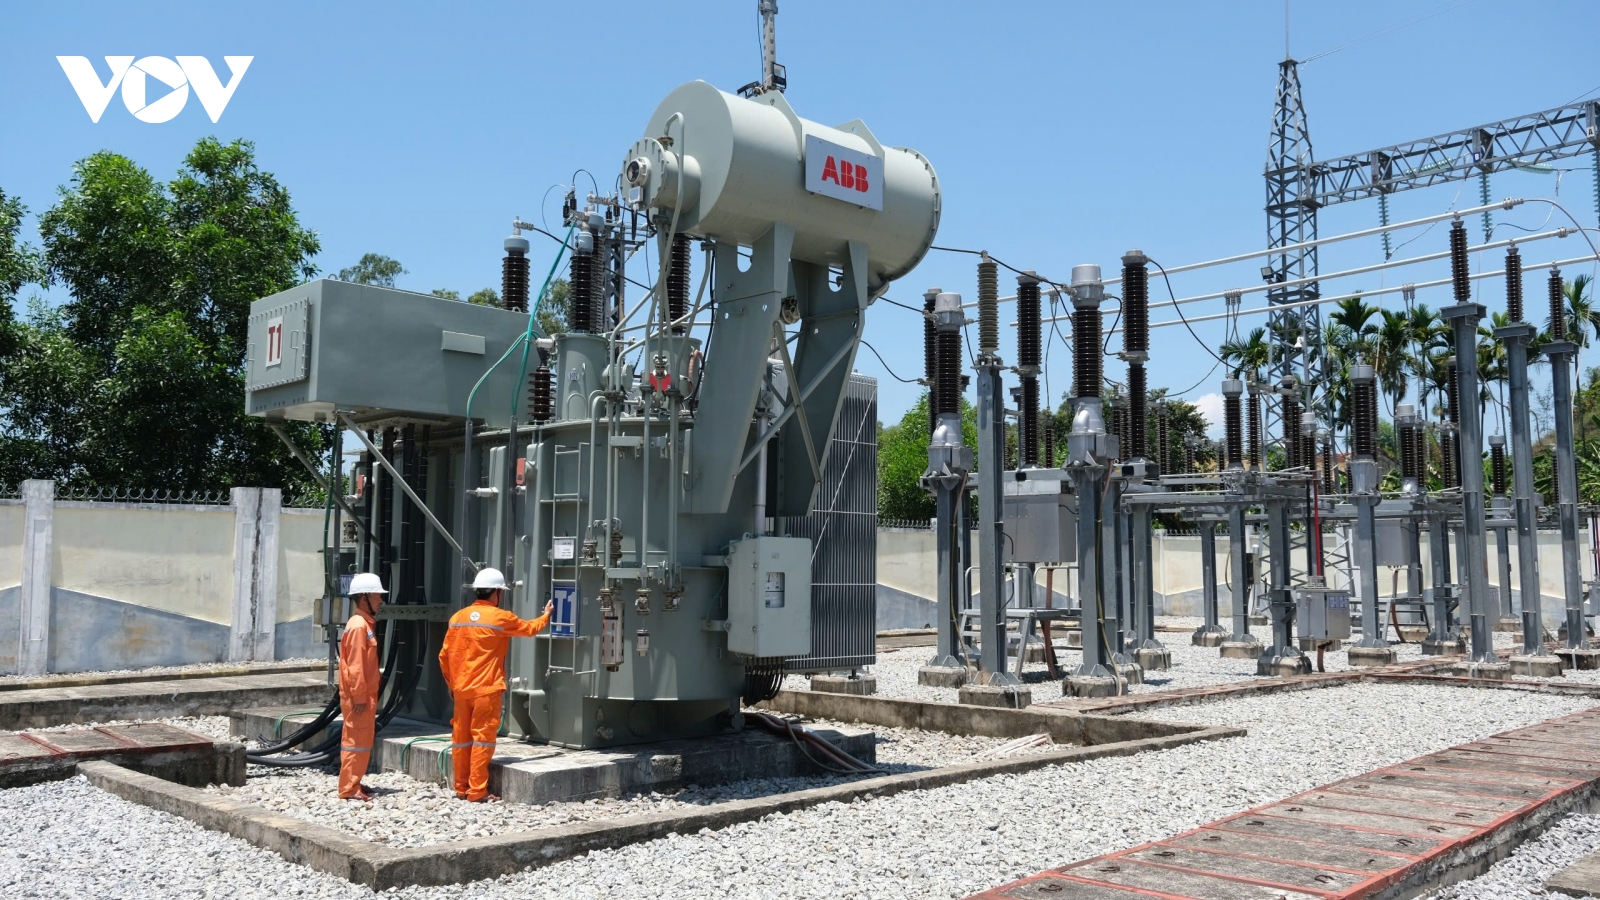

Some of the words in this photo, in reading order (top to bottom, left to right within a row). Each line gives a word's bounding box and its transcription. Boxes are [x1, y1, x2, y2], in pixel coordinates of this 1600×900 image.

[821, 155, 869, 193] ABB
[269, 323, 282, 362] T1
[555, 590, 576, 633] T1
